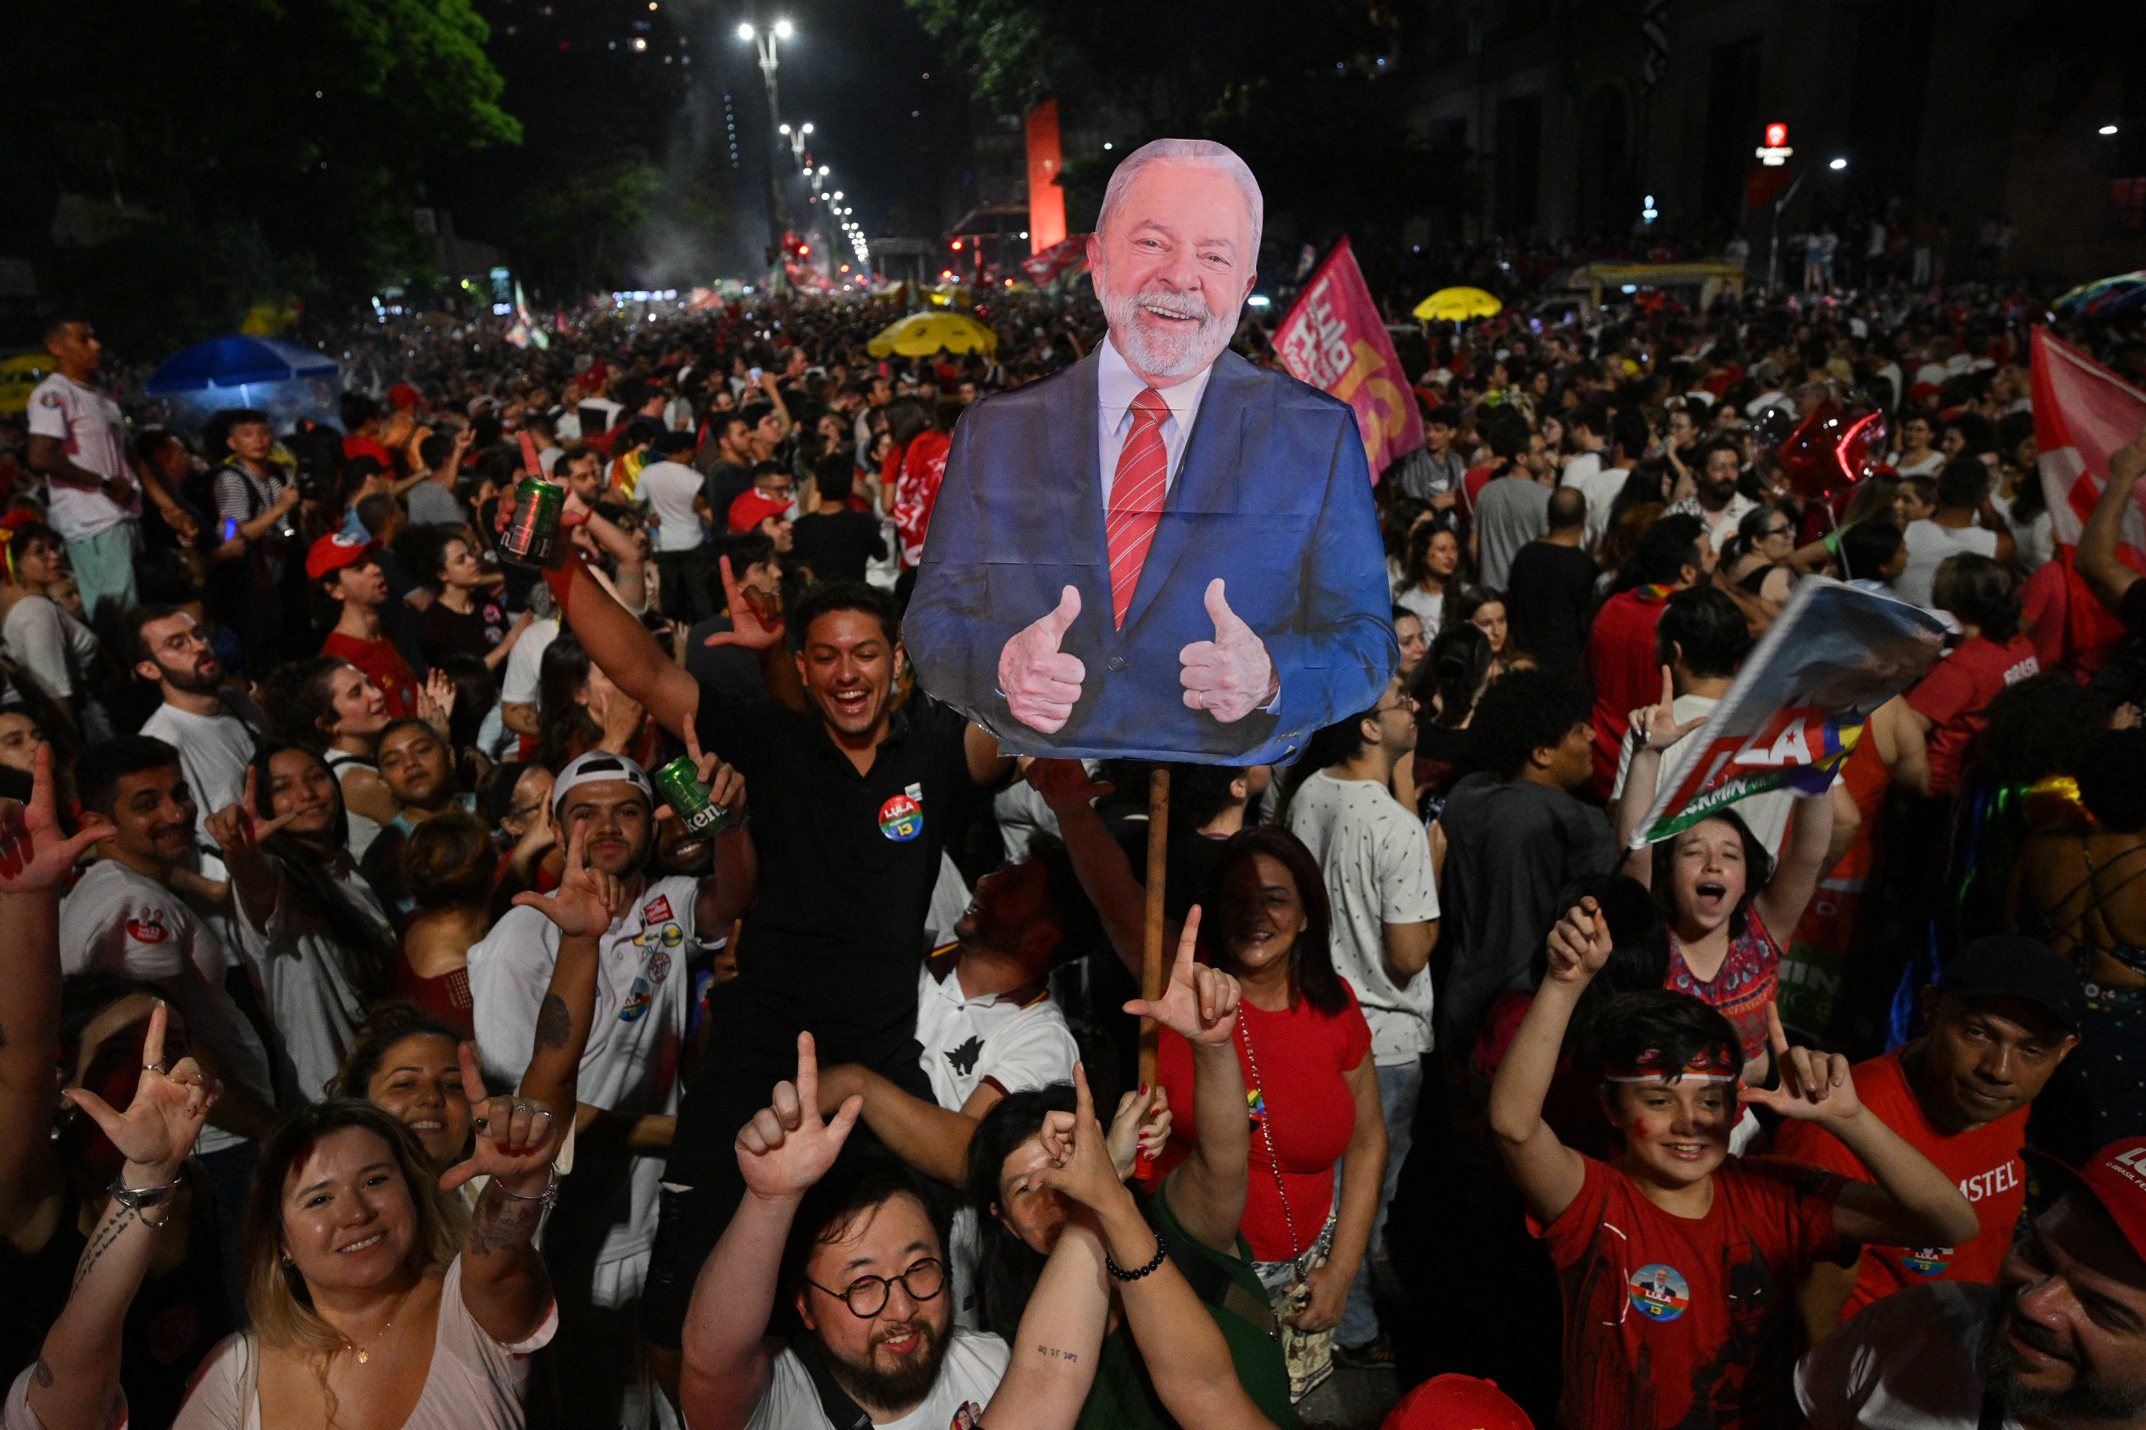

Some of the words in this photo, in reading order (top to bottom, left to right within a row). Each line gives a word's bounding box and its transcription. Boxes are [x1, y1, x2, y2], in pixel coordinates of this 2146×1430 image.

[1309, 276, 1353, 376] Lula
[884, 801, 915, 819] LULA
[897, 822, 914, 837] 13
[1645, 1289, 1672, 1303] LULA
[1651, 1305, 1662, 1315] 13
